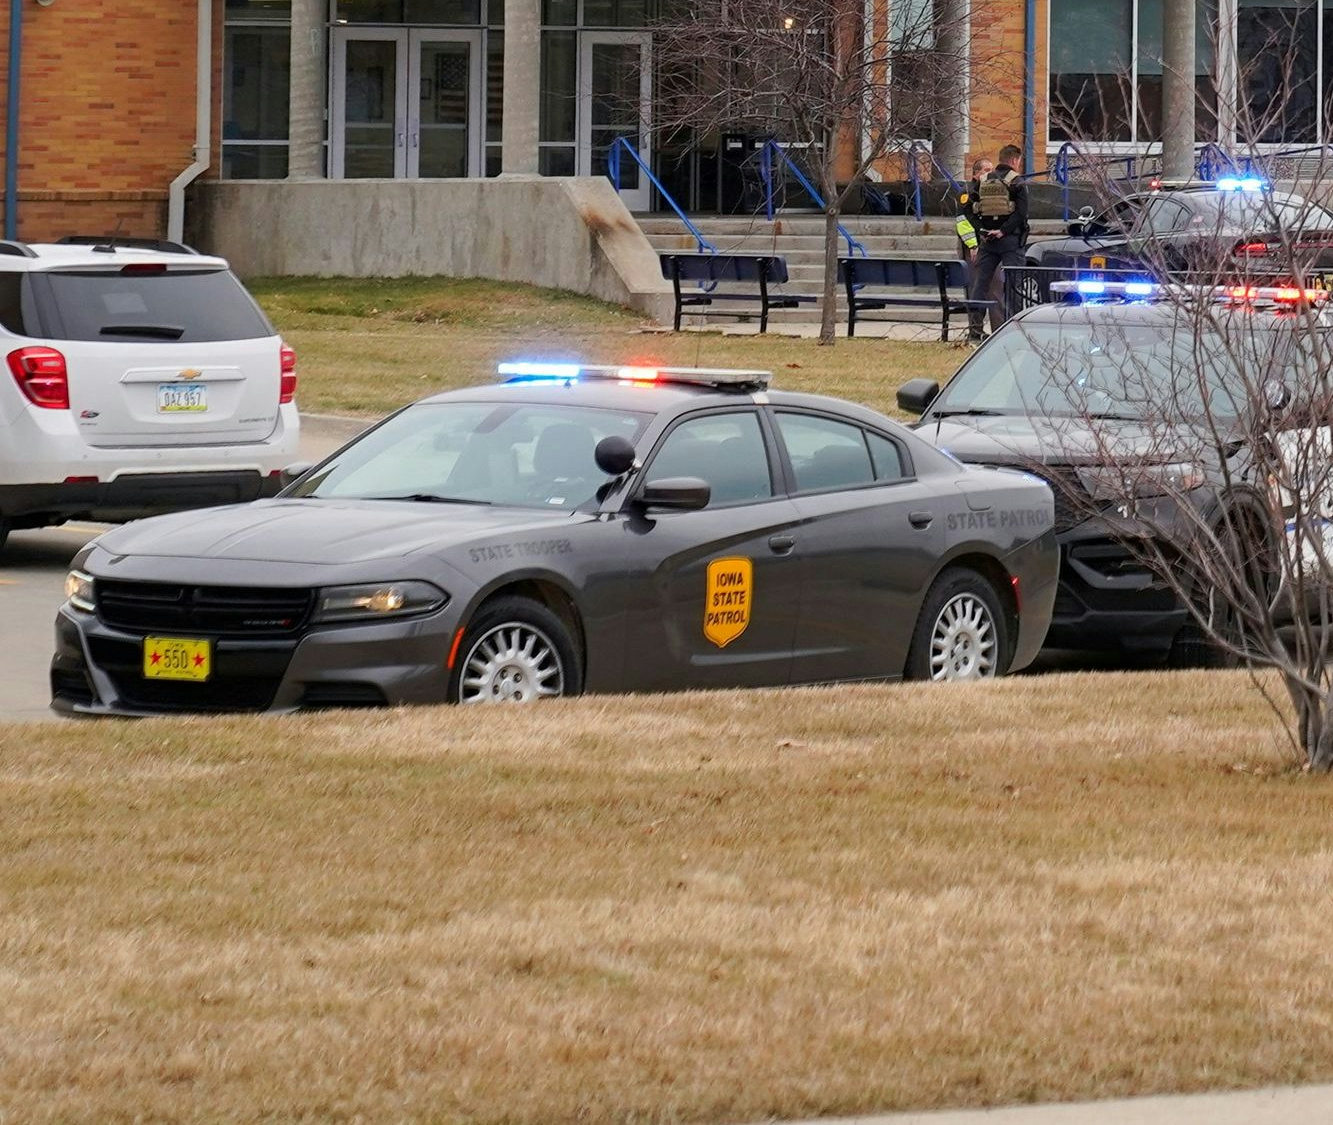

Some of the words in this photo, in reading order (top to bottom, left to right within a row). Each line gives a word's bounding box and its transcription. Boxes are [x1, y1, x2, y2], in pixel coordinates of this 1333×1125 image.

[947, 511, 996, 530] STATE
[1000, 509, 1049, 528] PATROL
[468, 544, 512, 563] STATE
[516, 539, 574, 558] TROOPER
[716, 573, 744, 587] IOWA
[712, 591, 746, 607] STATE
[707, 610, 746, 625] PATROL
[164, 649, 189, 669] 550
